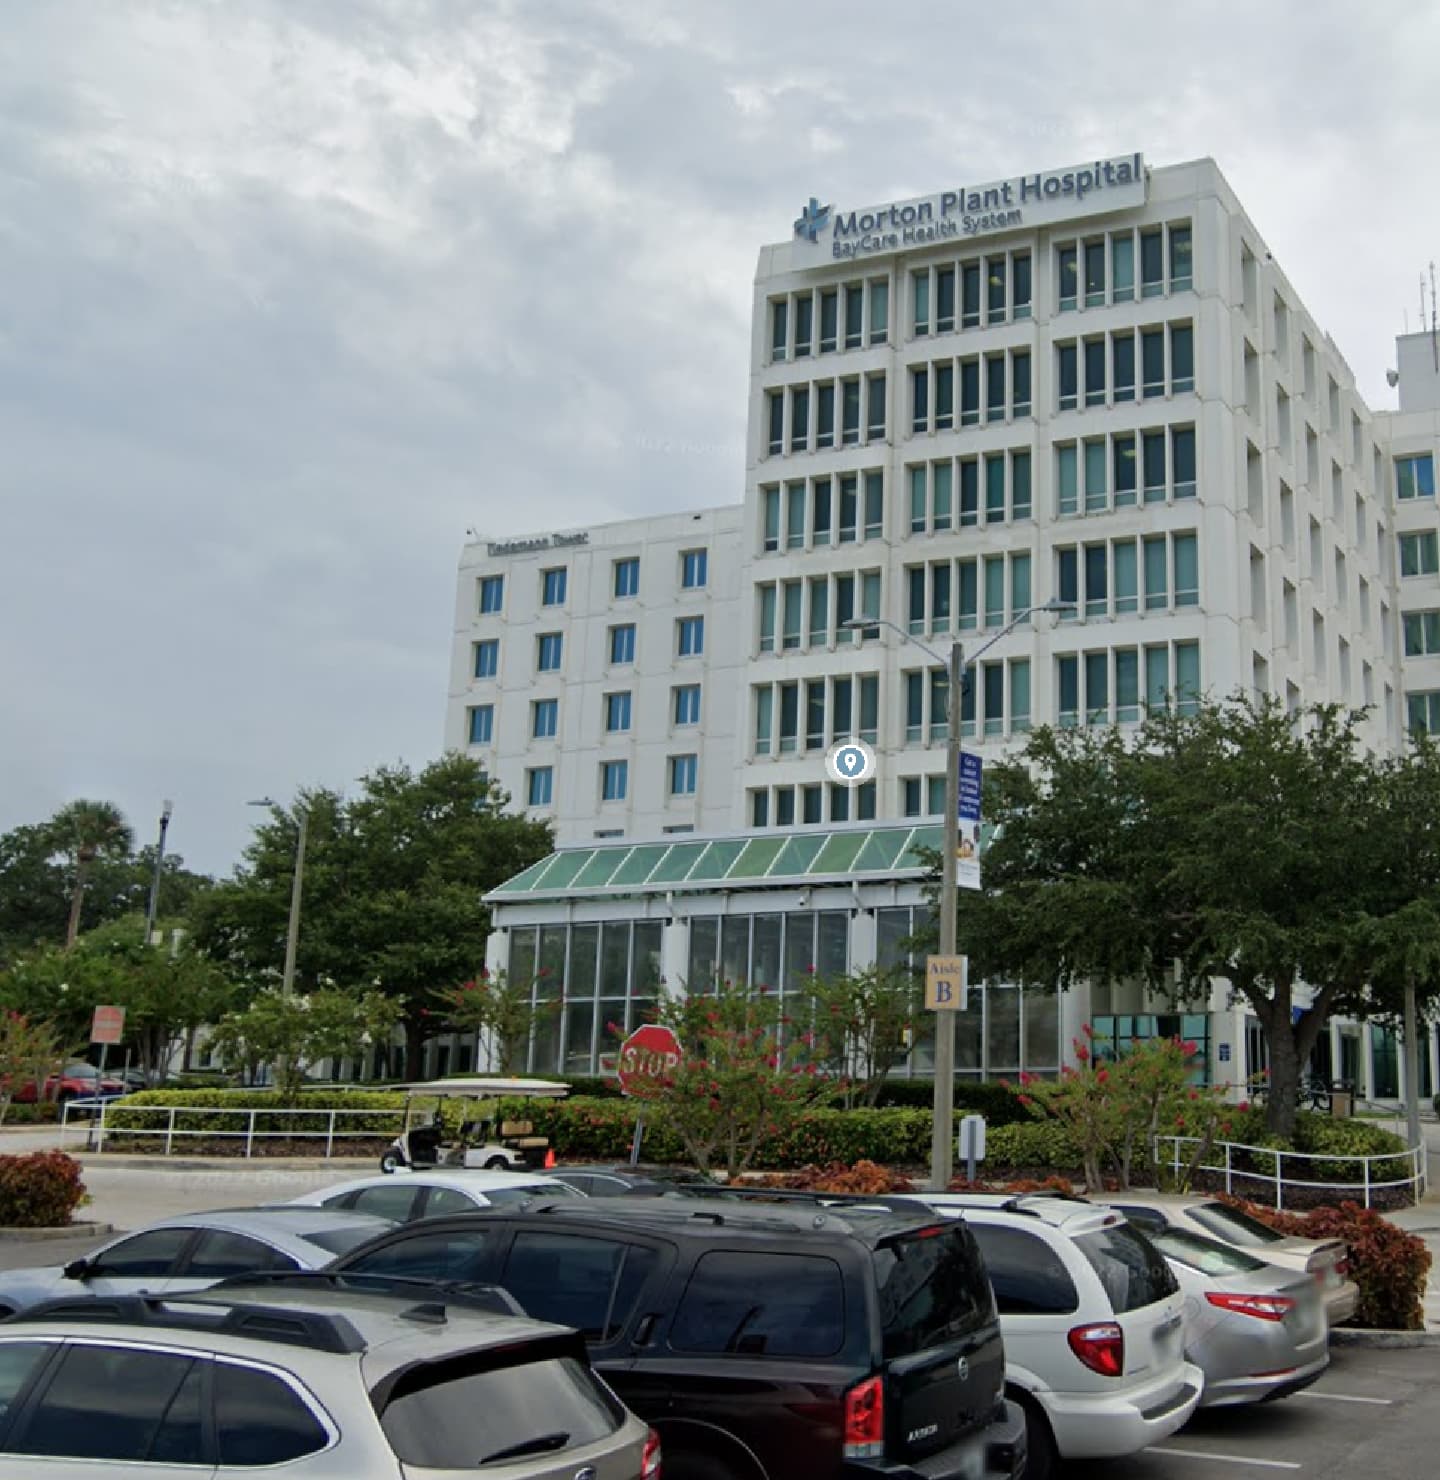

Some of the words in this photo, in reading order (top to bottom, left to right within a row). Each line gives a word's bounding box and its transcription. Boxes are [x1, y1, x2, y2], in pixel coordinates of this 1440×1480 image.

[833, 202, 933, 238] Morton
[940, 181, 1012, 217] Plant
[1020, 152, 1141, 202] Hospital
[832, 234, 898, 259] BayCare
[902, 219, 957, 243] Health
[963, 208, 1022, 235] System
[936, 980, 953, 1003] B
